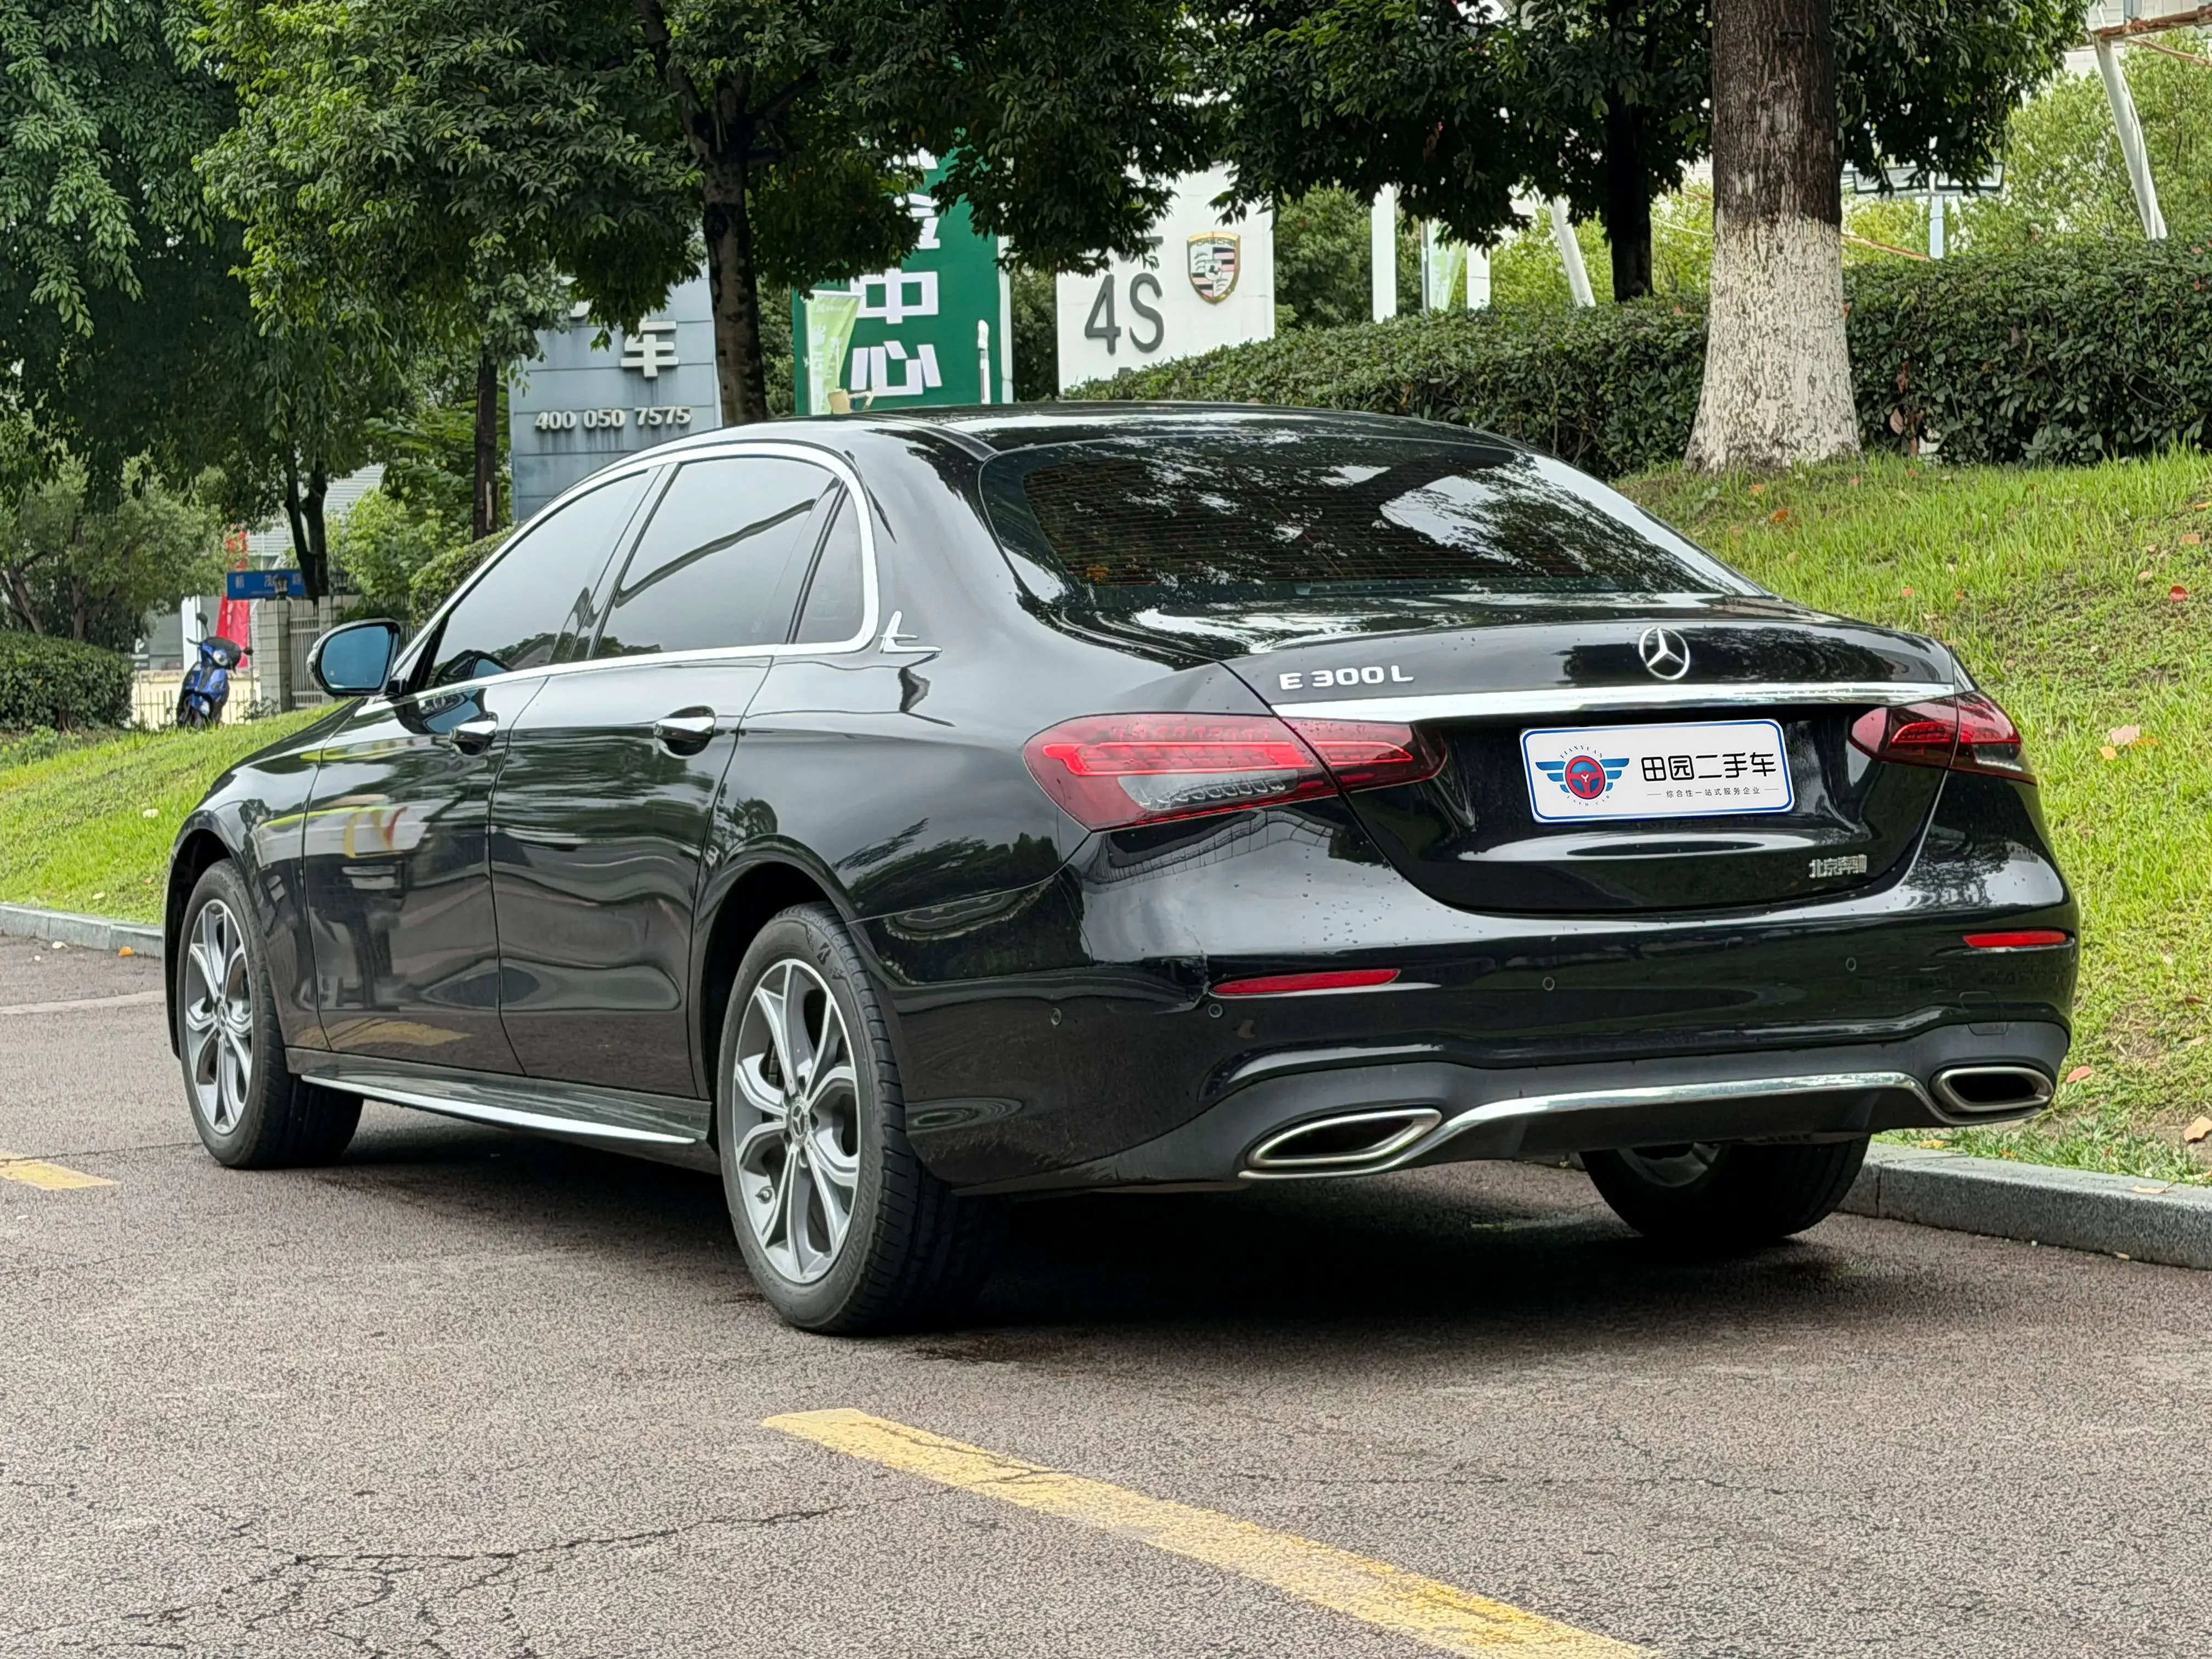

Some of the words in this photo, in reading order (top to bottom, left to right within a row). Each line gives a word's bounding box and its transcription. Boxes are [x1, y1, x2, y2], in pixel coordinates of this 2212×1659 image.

[1084, 272, 1165, 356] 4S
[534, 411, 577, 430] 400
[583, 409, 627, 428] 050
[634, 406, 691, 426] 7575
[1279, 673, 1304, 690] E
[1310, 667, 1384, 687] 300
[1390, 664, 1414, 682] L
[1641, 752, 1777, 782] 田园二手车
[1666, 786, 1760, 798] 综合性一站式服务企业
